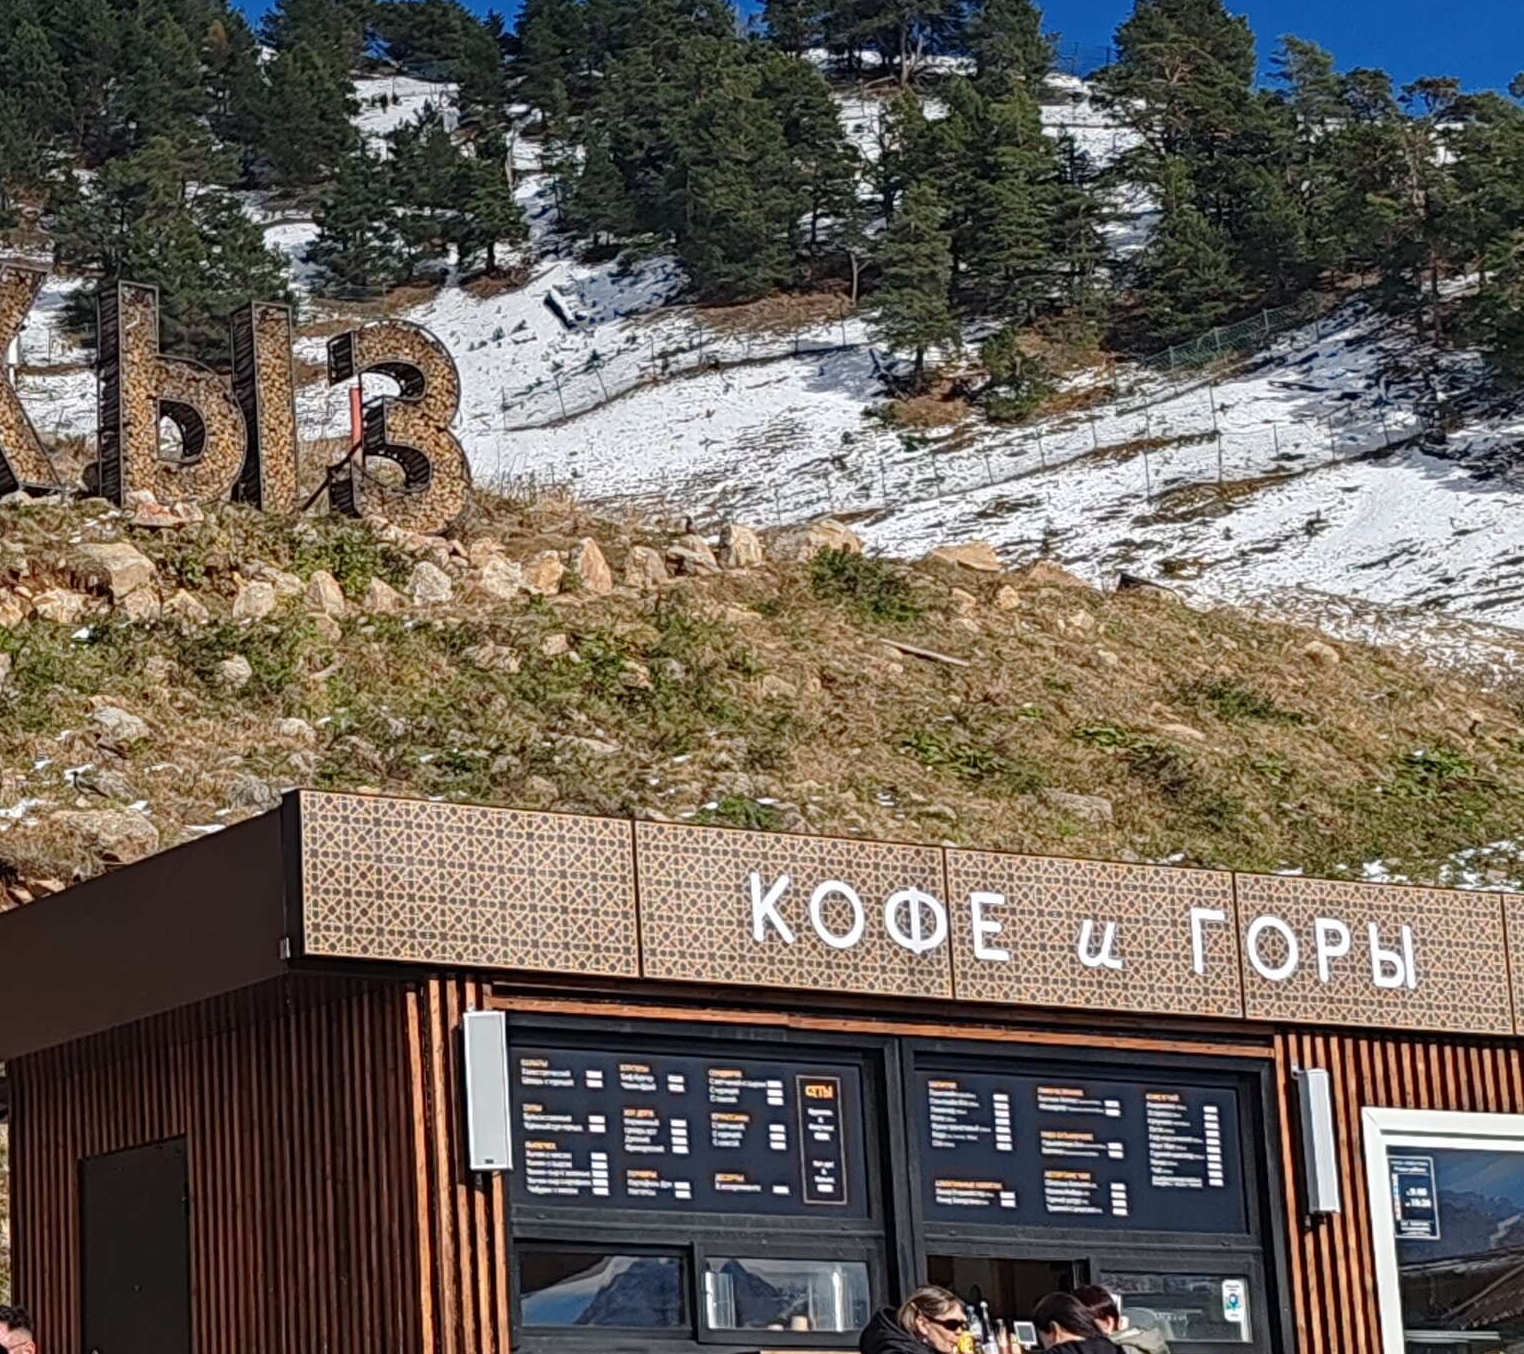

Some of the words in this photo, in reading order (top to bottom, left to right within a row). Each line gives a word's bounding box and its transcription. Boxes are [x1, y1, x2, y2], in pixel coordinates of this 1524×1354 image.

[749, 871, 1011, 963] КОФЕ
[1078, 917, 1124, 971] и
[1190, 906, 1417, 991] ГОРЫ
